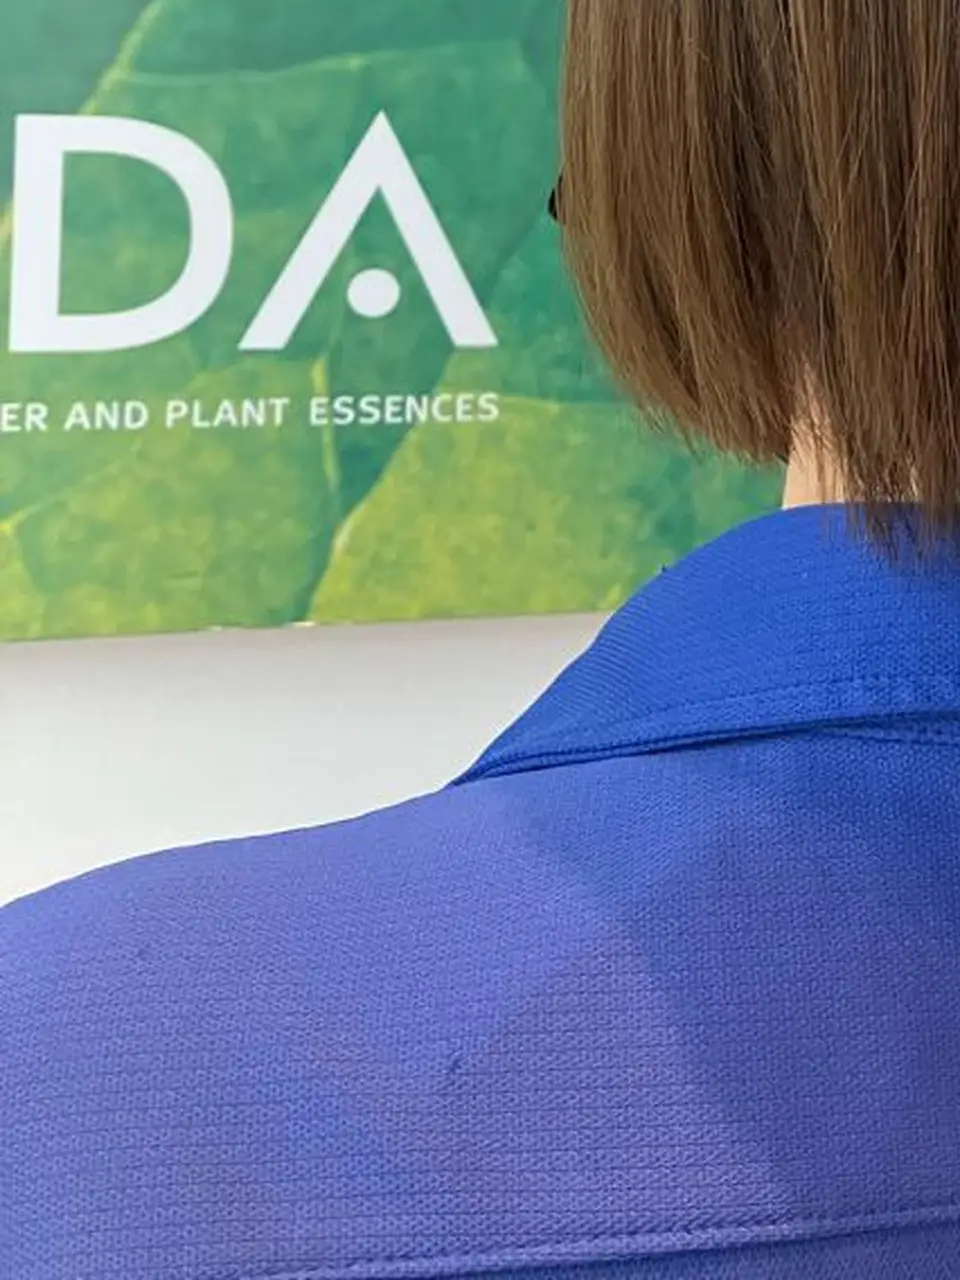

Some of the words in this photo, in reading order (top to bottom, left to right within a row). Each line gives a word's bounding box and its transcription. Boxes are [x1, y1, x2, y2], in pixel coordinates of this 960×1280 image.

[9, 110, 498, 352] DA
[0, 402, 48, 432] ER
[64, 401, 149, 431] AND
[166, 397, 290, 429] PLANT
[310, 392, 501, 426] ESSENCES
